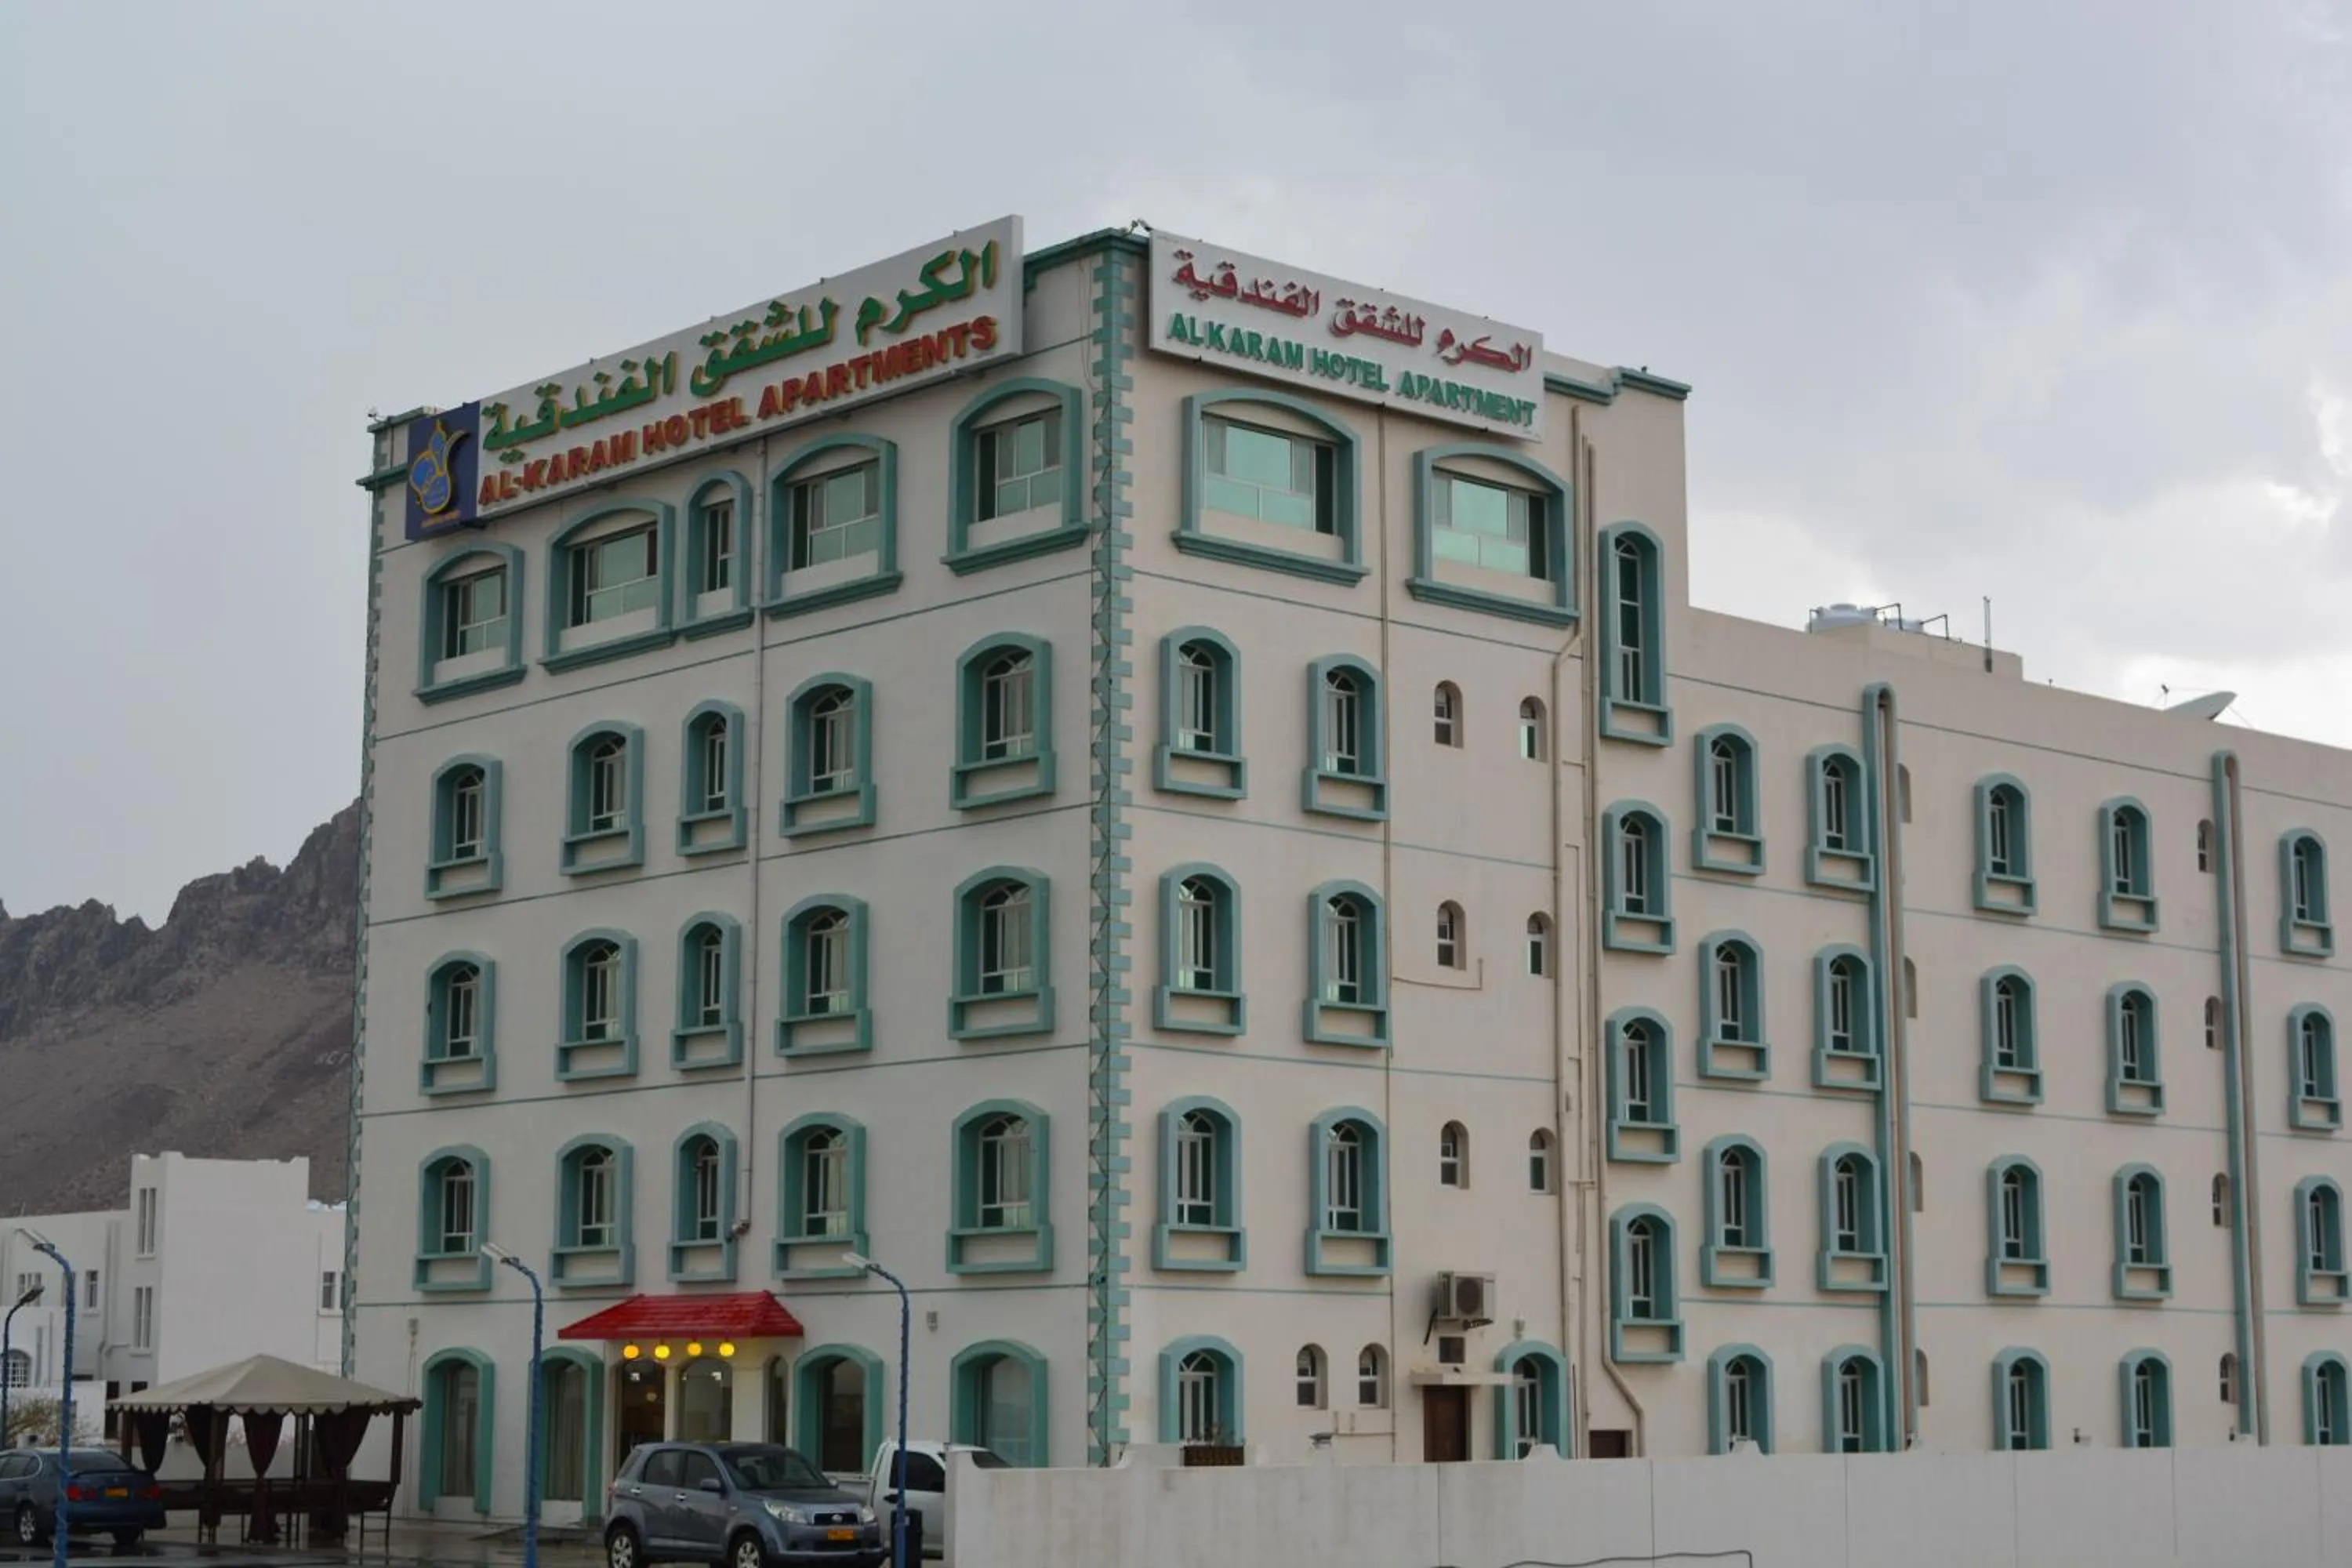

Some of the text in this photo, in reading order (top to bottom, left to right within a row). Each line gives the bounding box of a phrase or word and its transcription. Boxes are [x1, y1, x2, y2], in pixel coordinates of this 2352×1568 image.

[481, 240, 998, 464] الكرم للشقق الفندقية
[1172, 250, 1531, 372] الكرم للشقق الفندقية
[1308, 347, 1388, 392] HOTEL
[1396, 371, 1537, 426] APARTMENT
[478, 315, 996, 506] AL-KARAM HOTEL APARTMENTS
